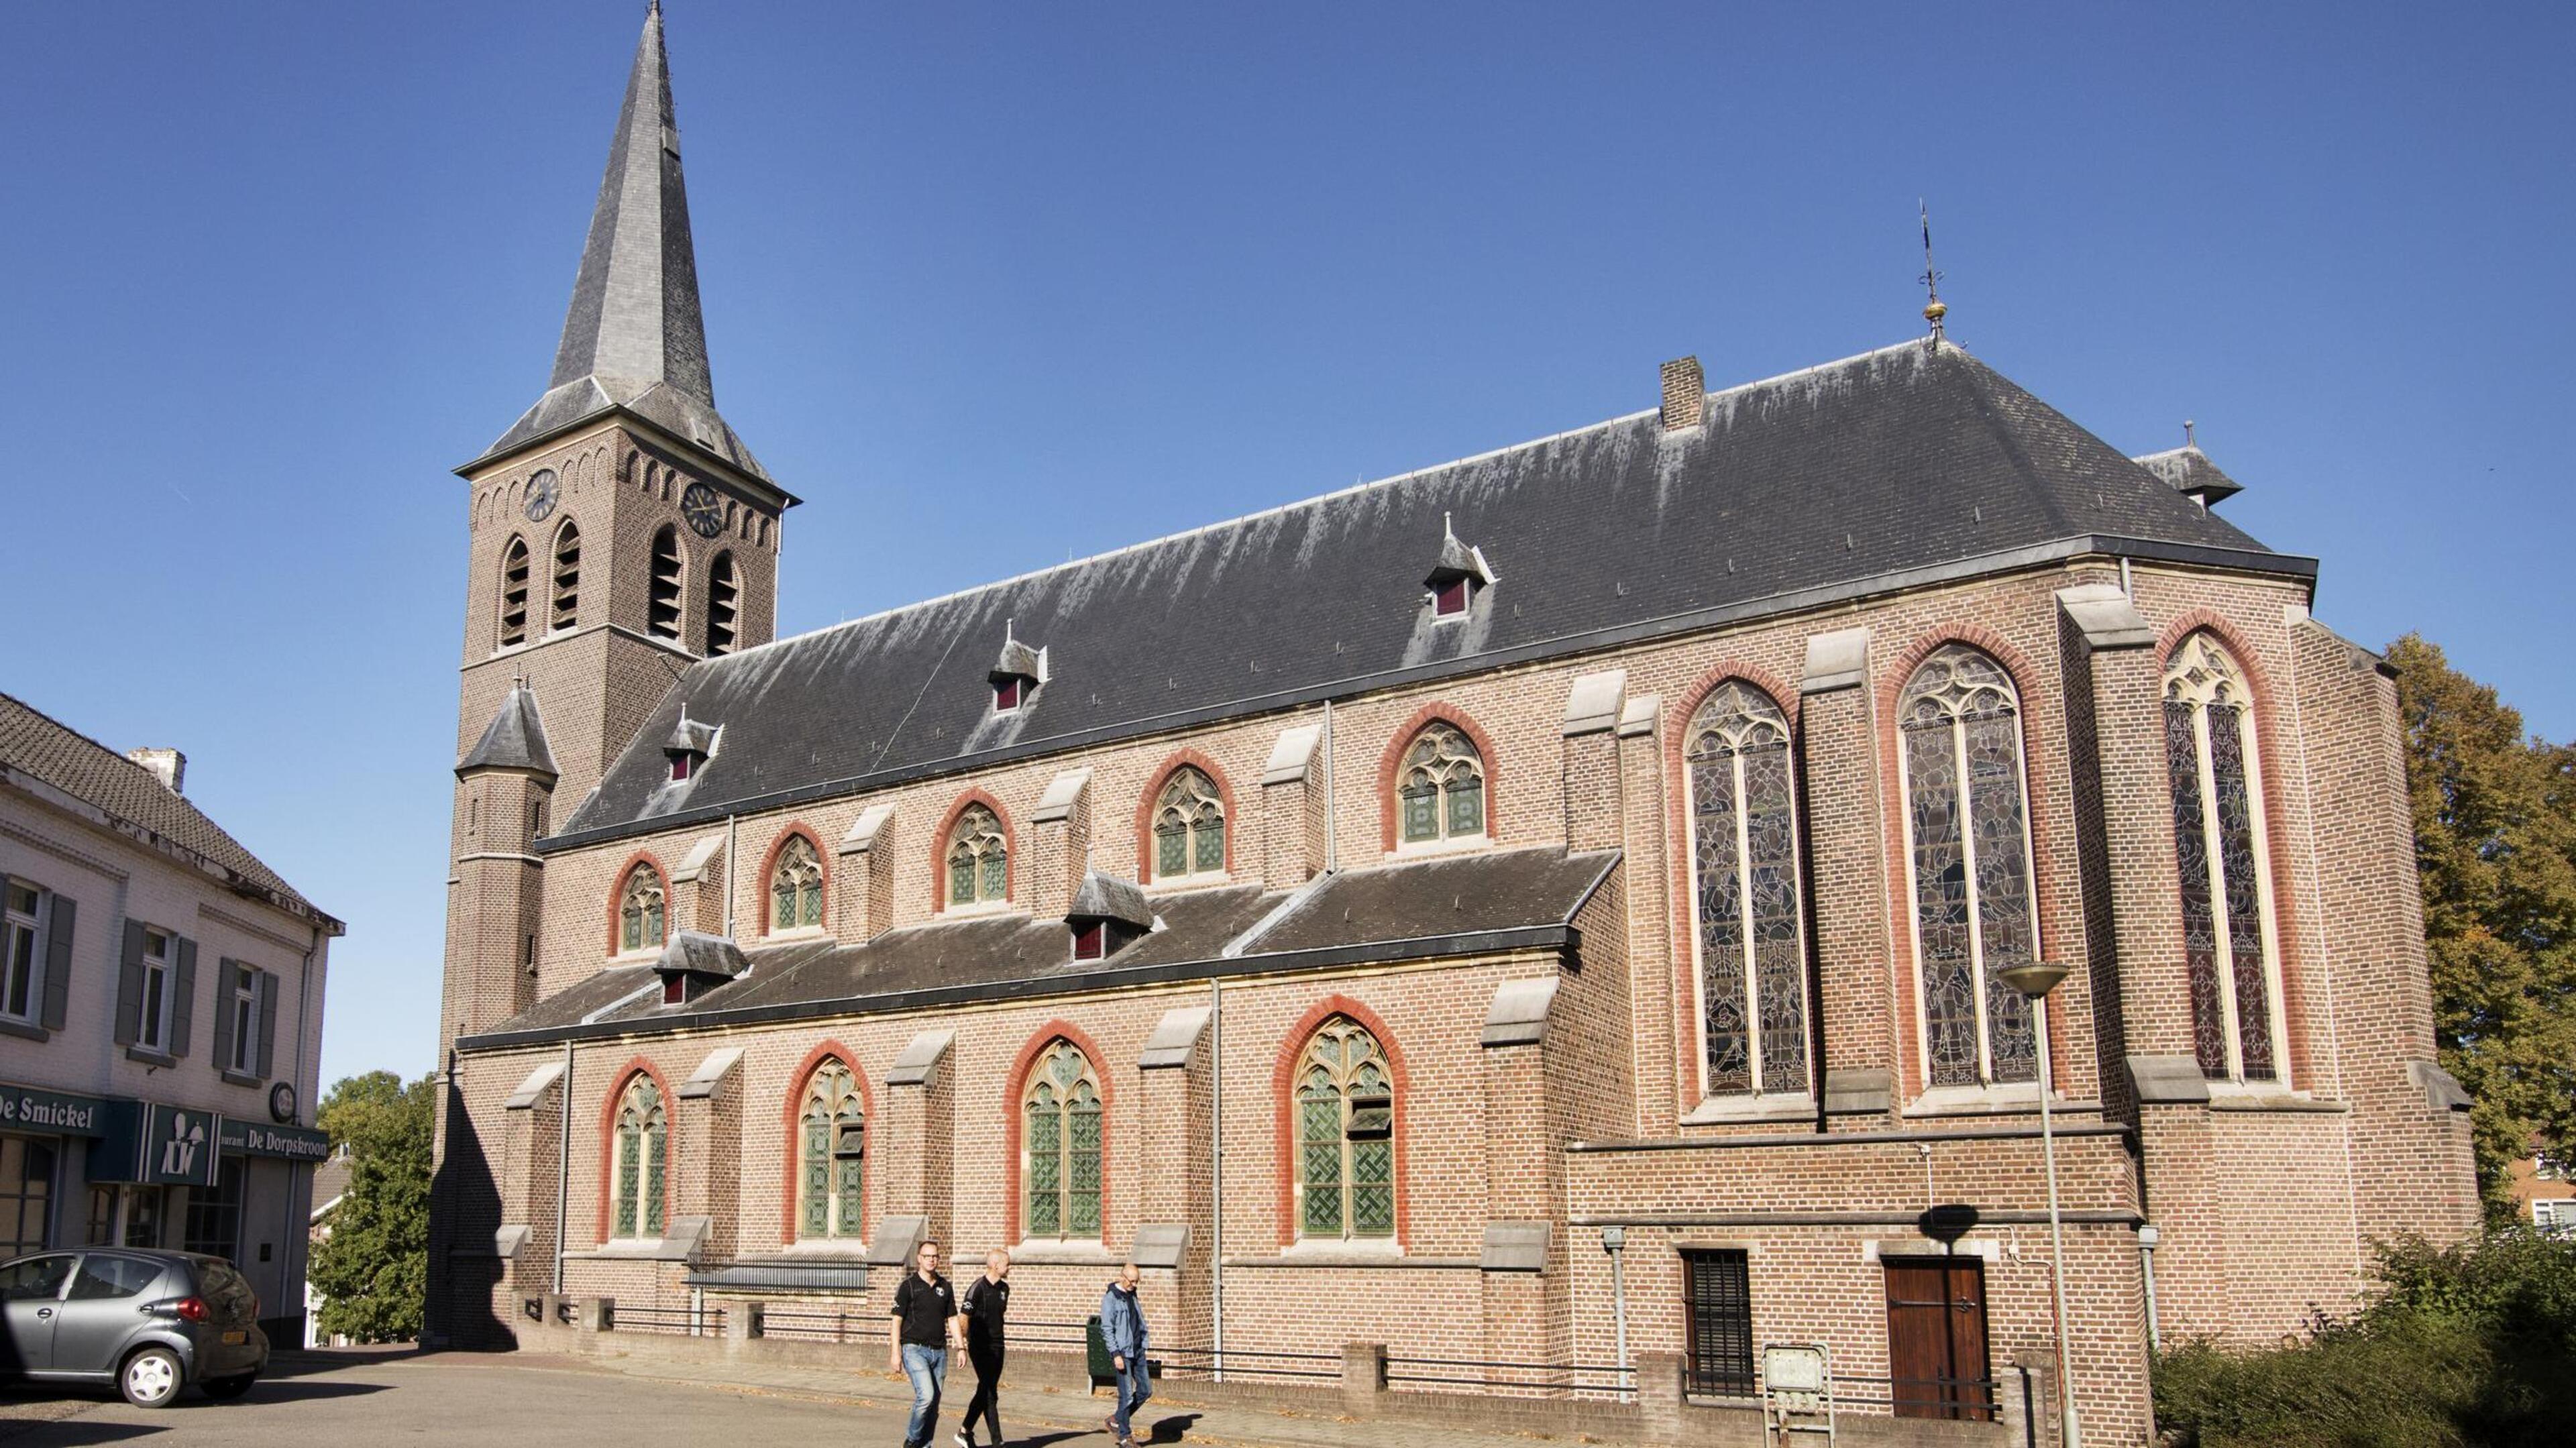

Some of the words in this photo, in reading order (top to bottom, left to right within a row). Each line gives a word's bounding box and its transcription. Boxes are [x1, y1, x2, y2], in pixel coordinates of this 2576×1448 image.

[0, 1095, 14, 1119] e
[19, 1097, 93, 1129] Smickel
[248, 1129, 264, 1149] De
[266, 1131, 327, 1156] Dorpskroon
